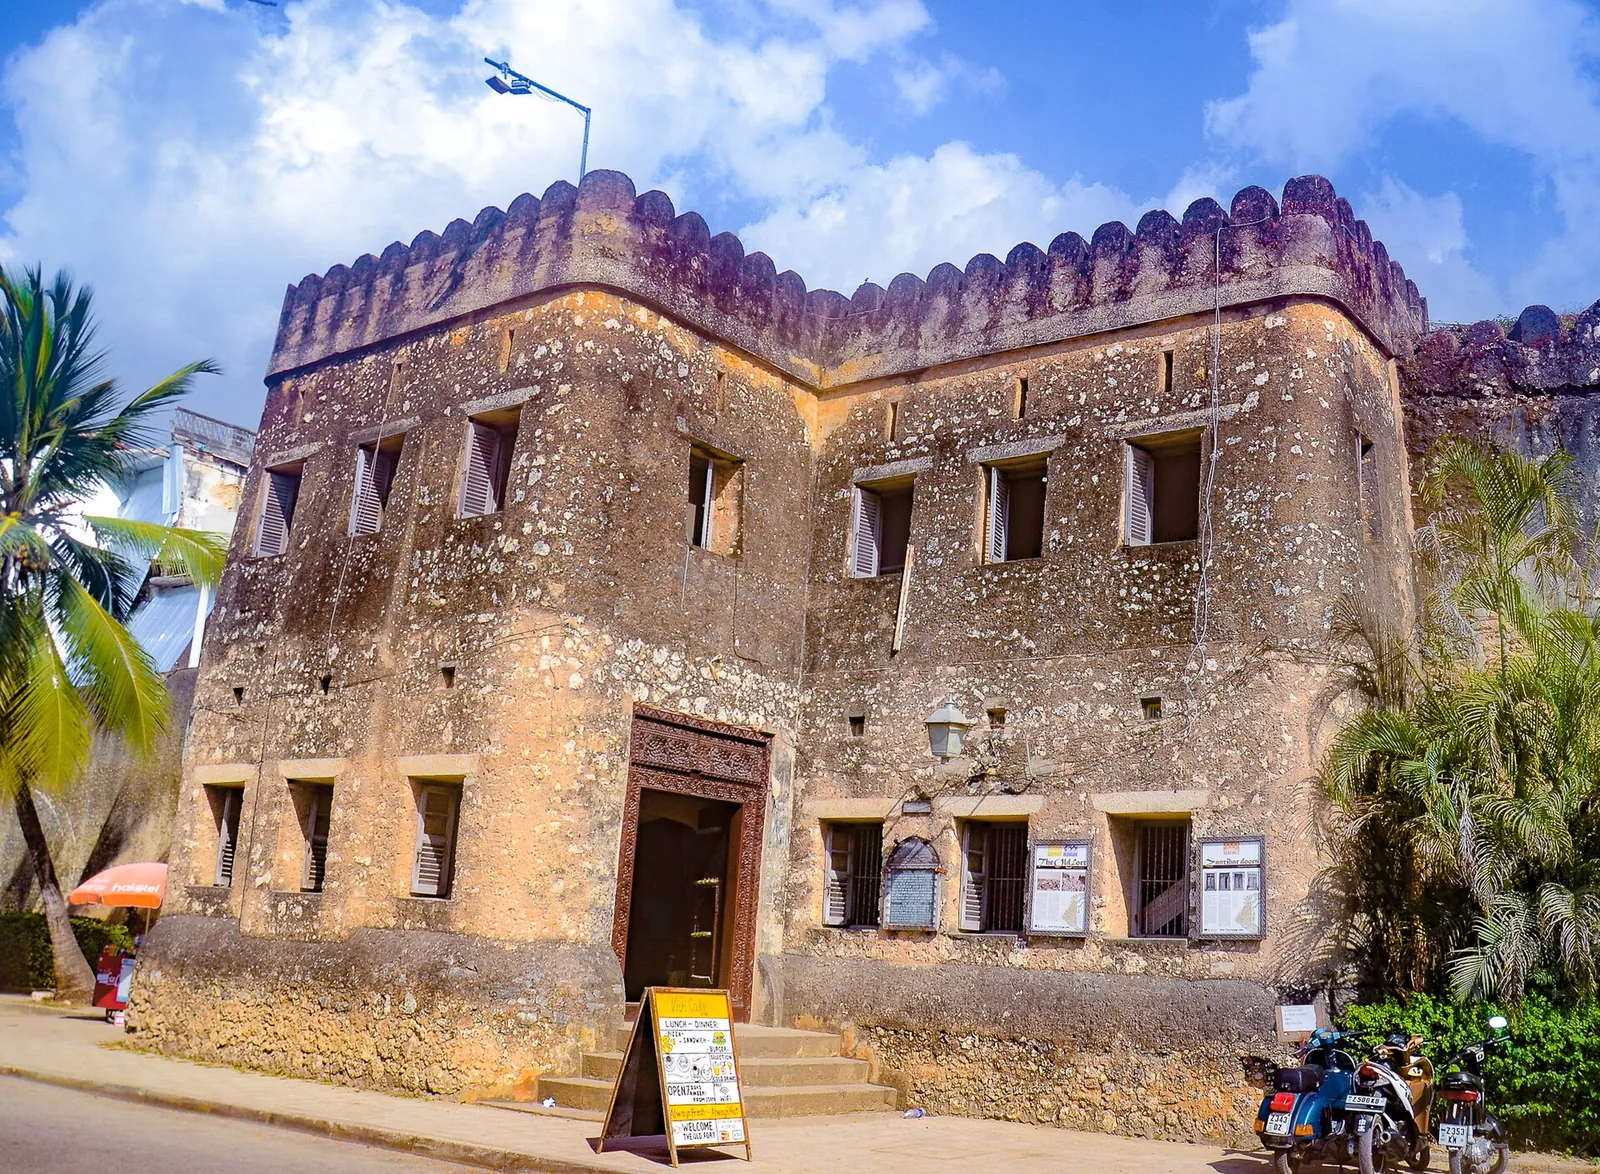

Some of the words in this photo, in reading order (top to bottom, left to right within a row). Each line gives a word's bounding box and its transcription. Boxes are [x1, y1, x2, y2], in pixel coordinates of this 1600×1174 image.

[667, 1085, 686, 1096] OPEN
[682, 1121, 713, 1131] WELCOME
[1446, 1127, 1464, 1135] Z353
